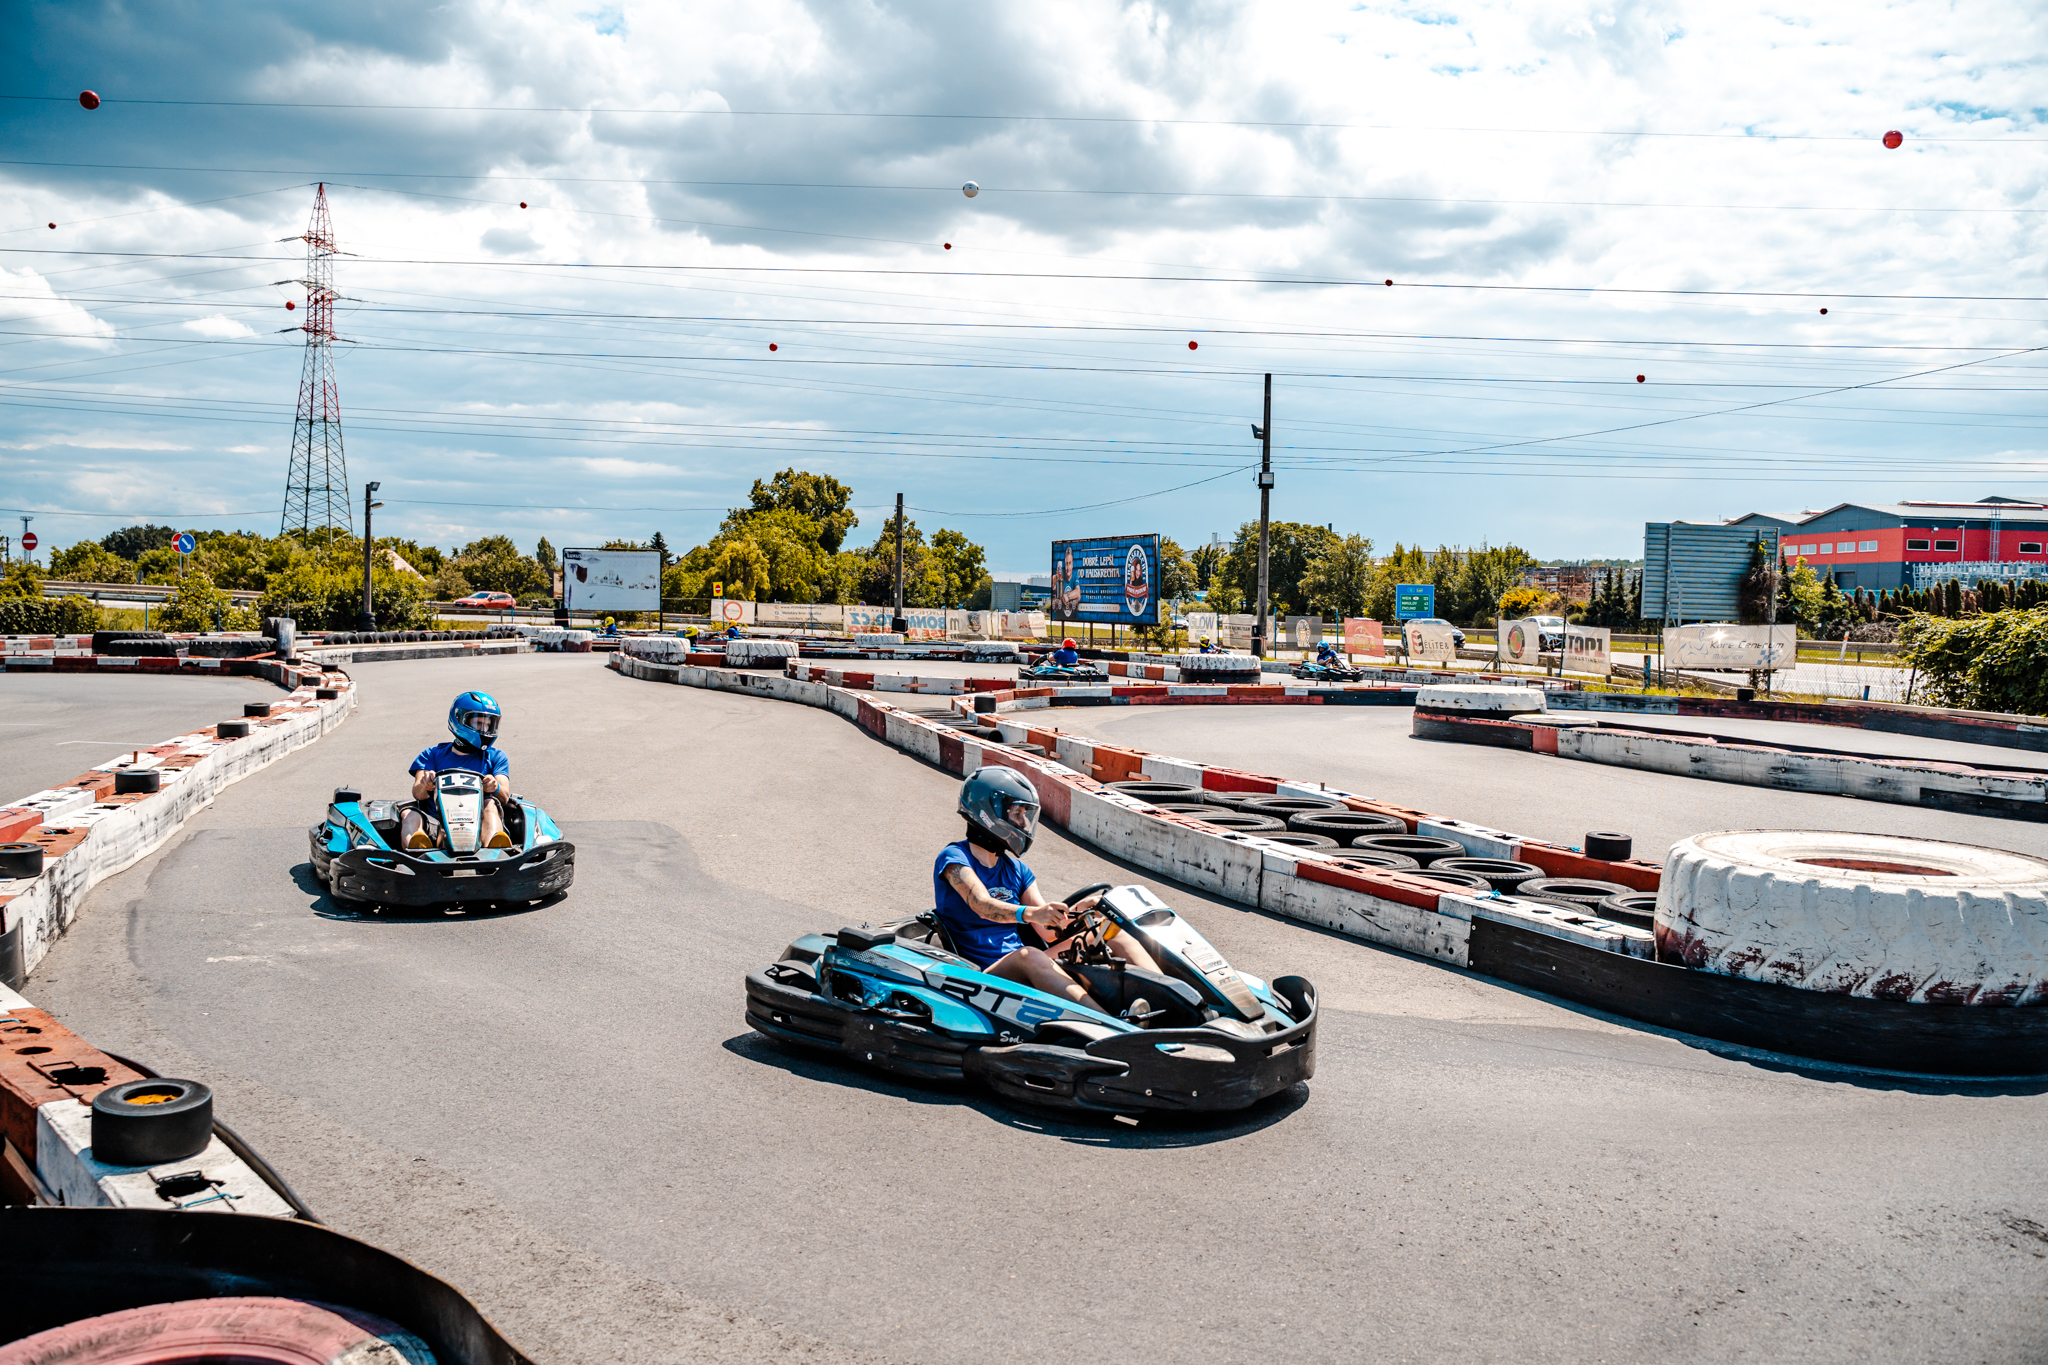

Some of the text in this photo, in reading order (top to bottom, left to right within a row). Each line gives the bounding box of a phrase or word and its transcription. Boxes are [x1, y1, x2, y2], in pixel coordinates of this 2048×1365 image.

[1709, 640, 1784, 649] Kart Centrum
[441, 775, 477, 787] 17
[939, 977, 1065, 1024] RT8
